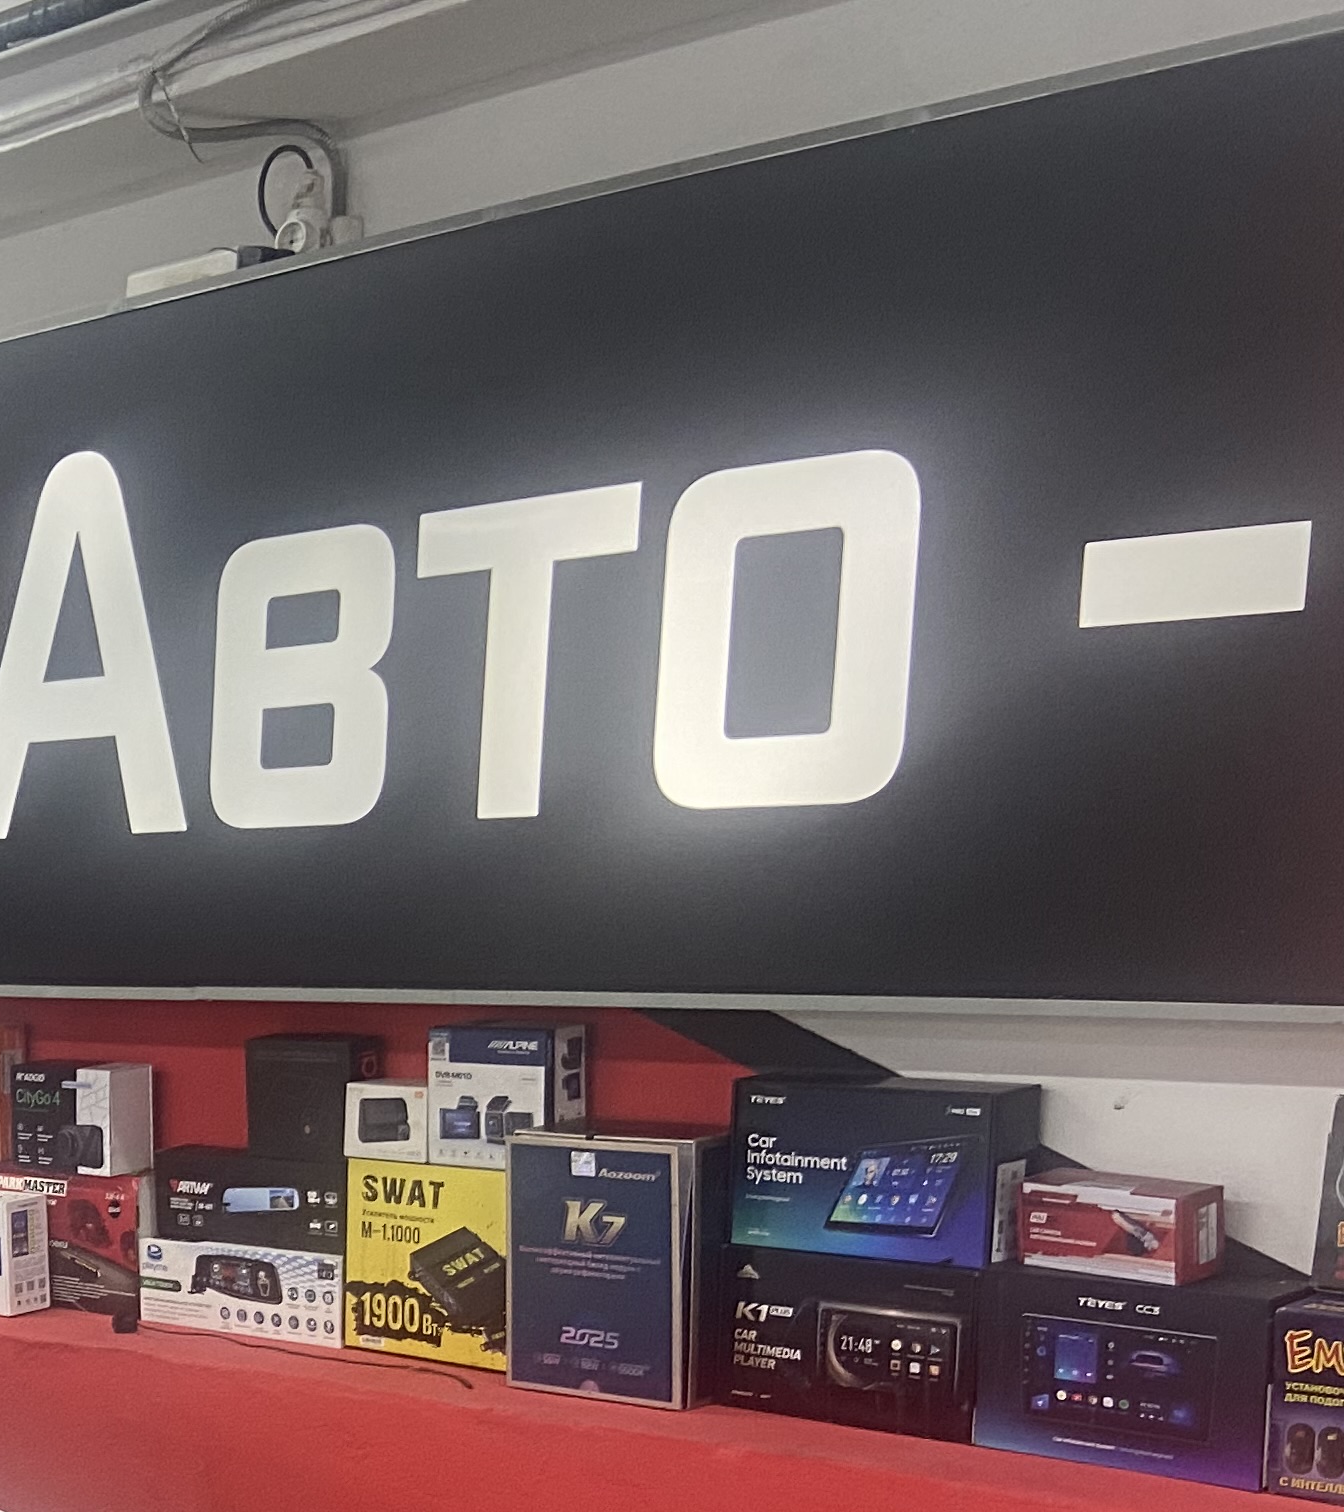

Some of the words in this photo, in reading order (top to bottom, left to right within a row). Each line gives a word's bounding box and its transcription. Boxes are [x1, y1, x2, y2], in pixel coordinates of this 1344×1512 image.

[747, 1133, 777, 1149] Car
[746, 1149, 848, 1171] Infotainment
[598, 1167, 656, 1183] Aozoom
[746, 1166, 803, 1185] System
[362, 1174, 445, 1210] SWAT
[361, 1221, 420, 1244] M-1.1000
[562, 1199, 627, 1245] K7
[442, 1248, 484, 1276] SWAT
[361, 1292, 419, 1333] 1900
[735, 1301, 769, 1322] K1
[560, 1326, 619, 1349] 2025
[734, 1328, 758, 1340] CAR
[734, 1342, 802, 1361] MULTIMEDIA
[733, 1355, 776, 1370] PLAYER
